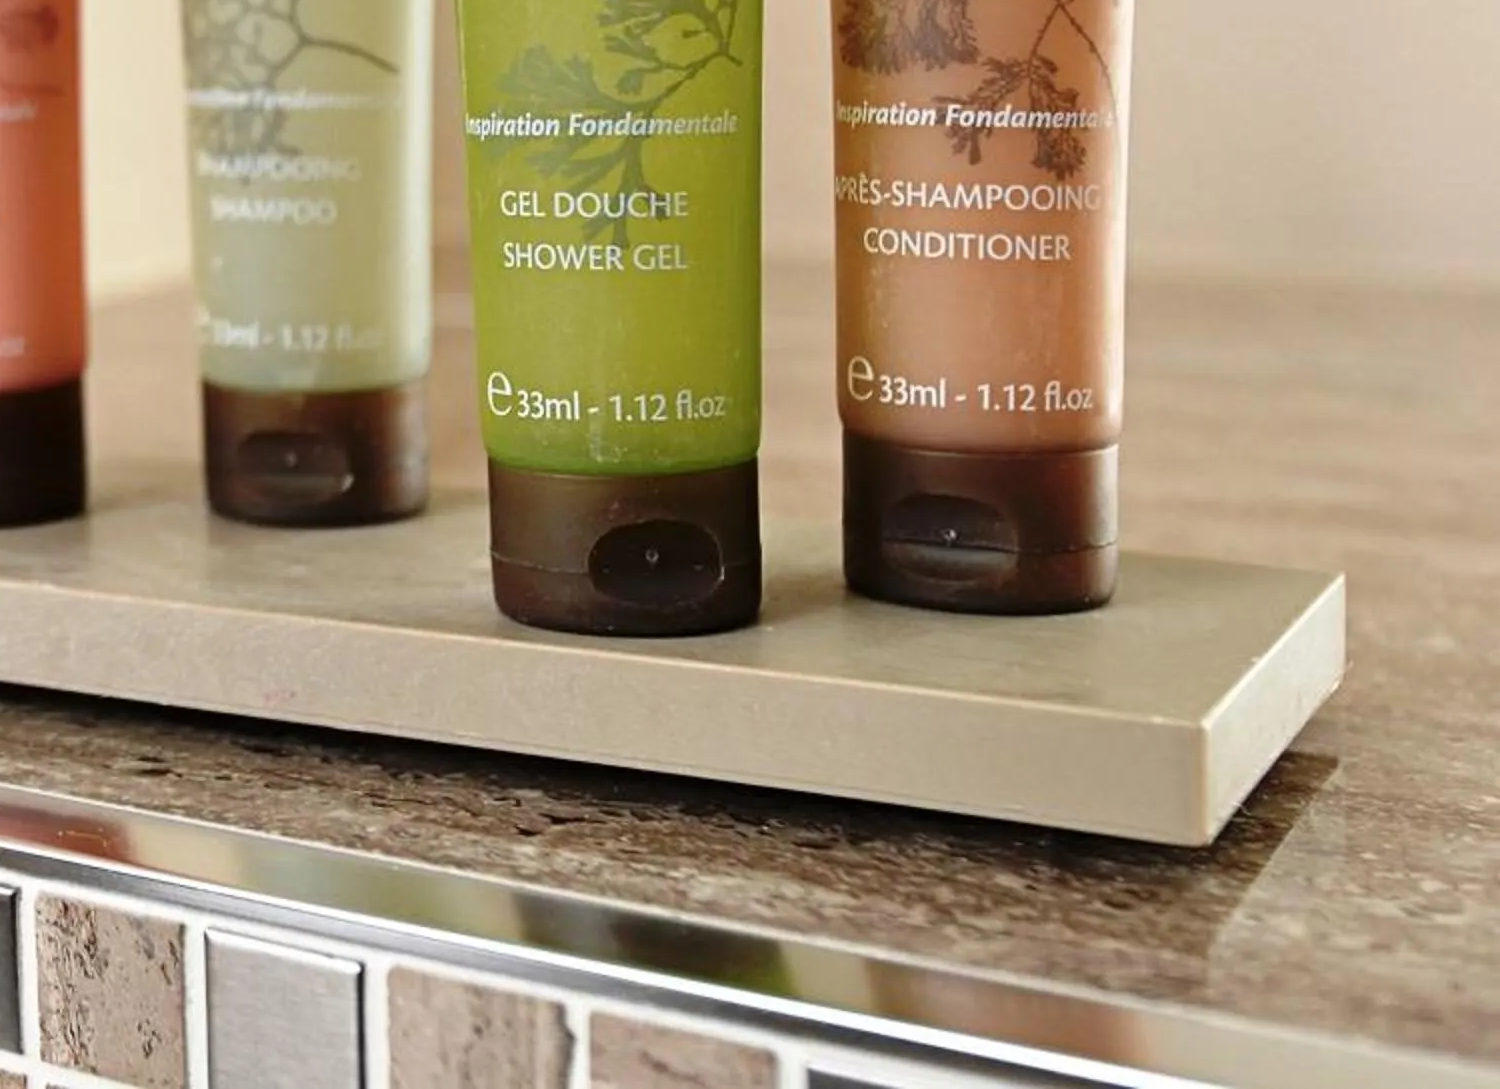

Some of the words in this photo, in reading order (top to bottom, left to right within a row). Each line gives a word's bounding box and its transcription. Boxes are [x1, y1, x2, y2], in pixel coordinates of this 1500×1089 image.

[568, 109, 739, 136] Fondamentale
[500, 190, 545, 217] GEL
[553, 191, 689, 218] DOUCHE
[503, 243, 624, 271] SHOWER
[632, 244, 688, 270] GEL
[863, 227, 1071, 261] CONDITIONER
[609, 394, 668, 422] 1.12
[676, 389, 726, 420] fl.oz
[977, 383, 1037, 412] 1.12
[1044, 380, 1093, 410] fl.oz
